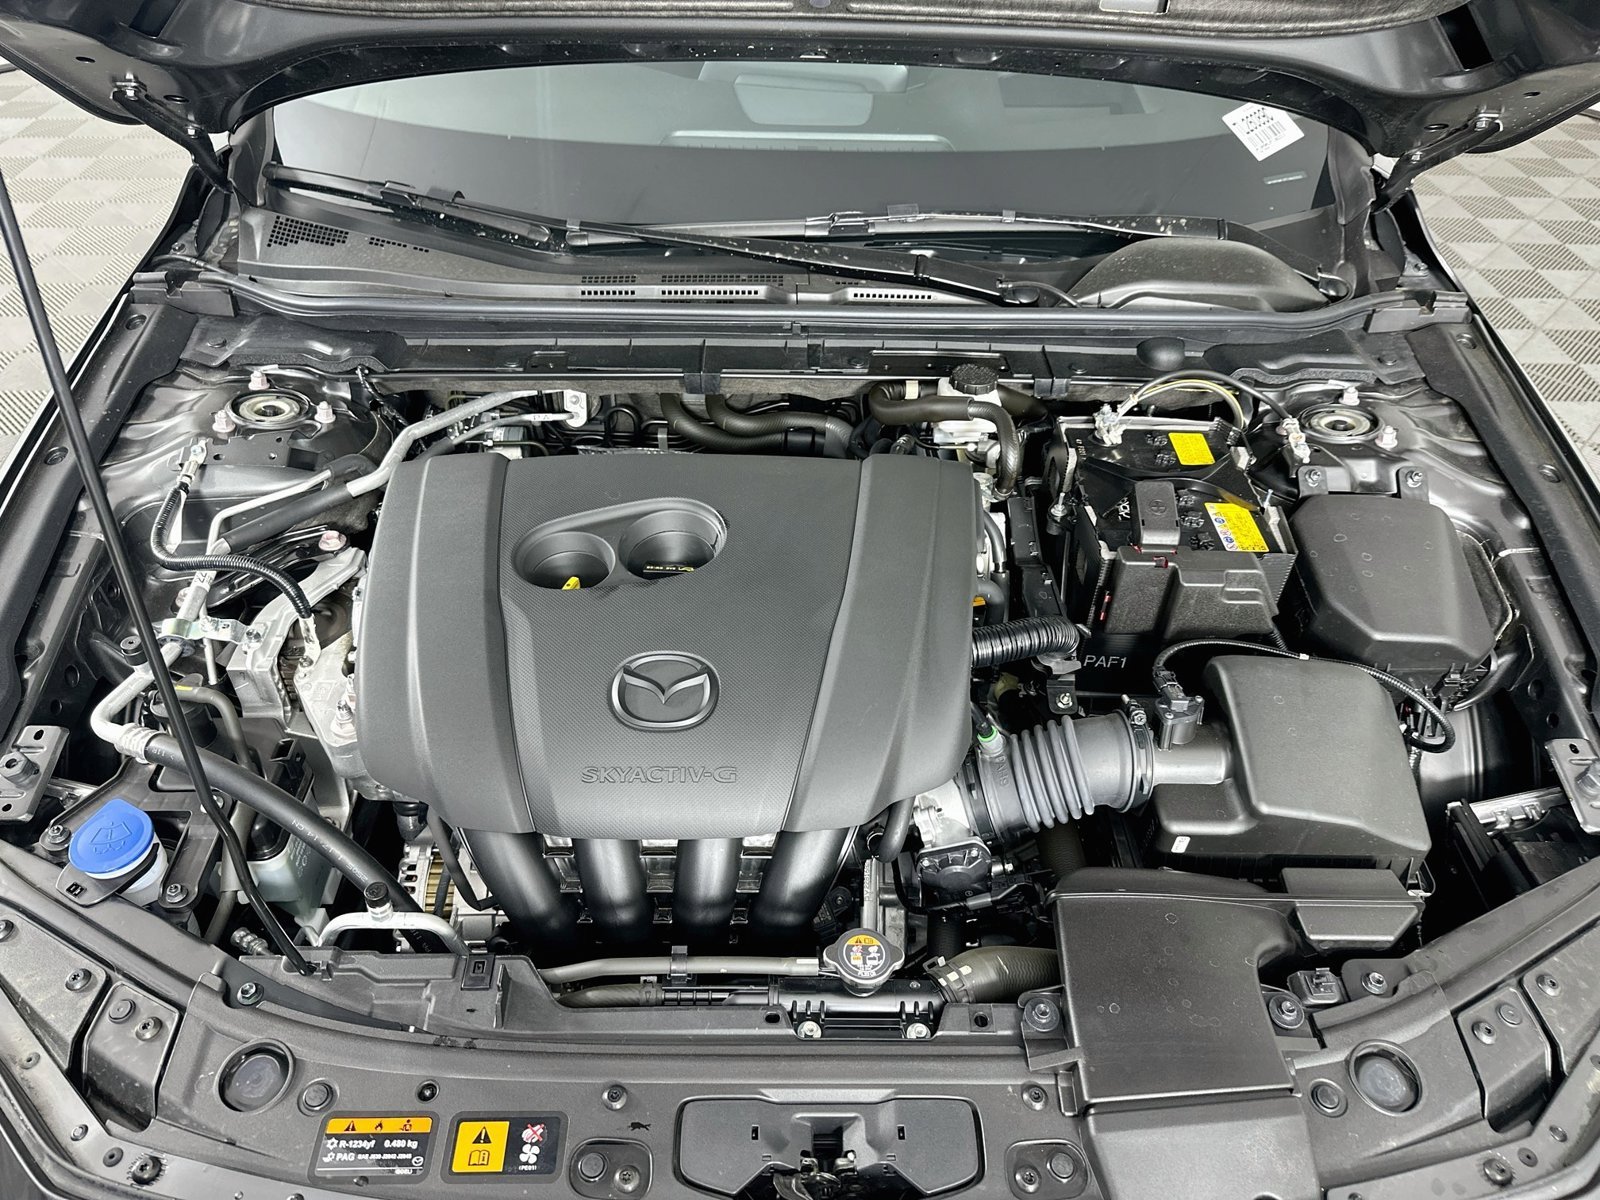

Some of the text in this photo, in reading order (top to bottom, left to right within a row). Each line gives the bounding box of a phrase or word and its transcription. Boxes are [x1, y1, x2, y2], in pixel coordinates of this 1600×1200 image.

[1083, 654, 1127, 669] PAF1
[581, 766, 738, 784] SKYACTIV-G
[339, 1139, 376, 1150] R-1234yf
[406, 1139, 418, 1149] kg
[335, 1152, 356, 1161] PAG
